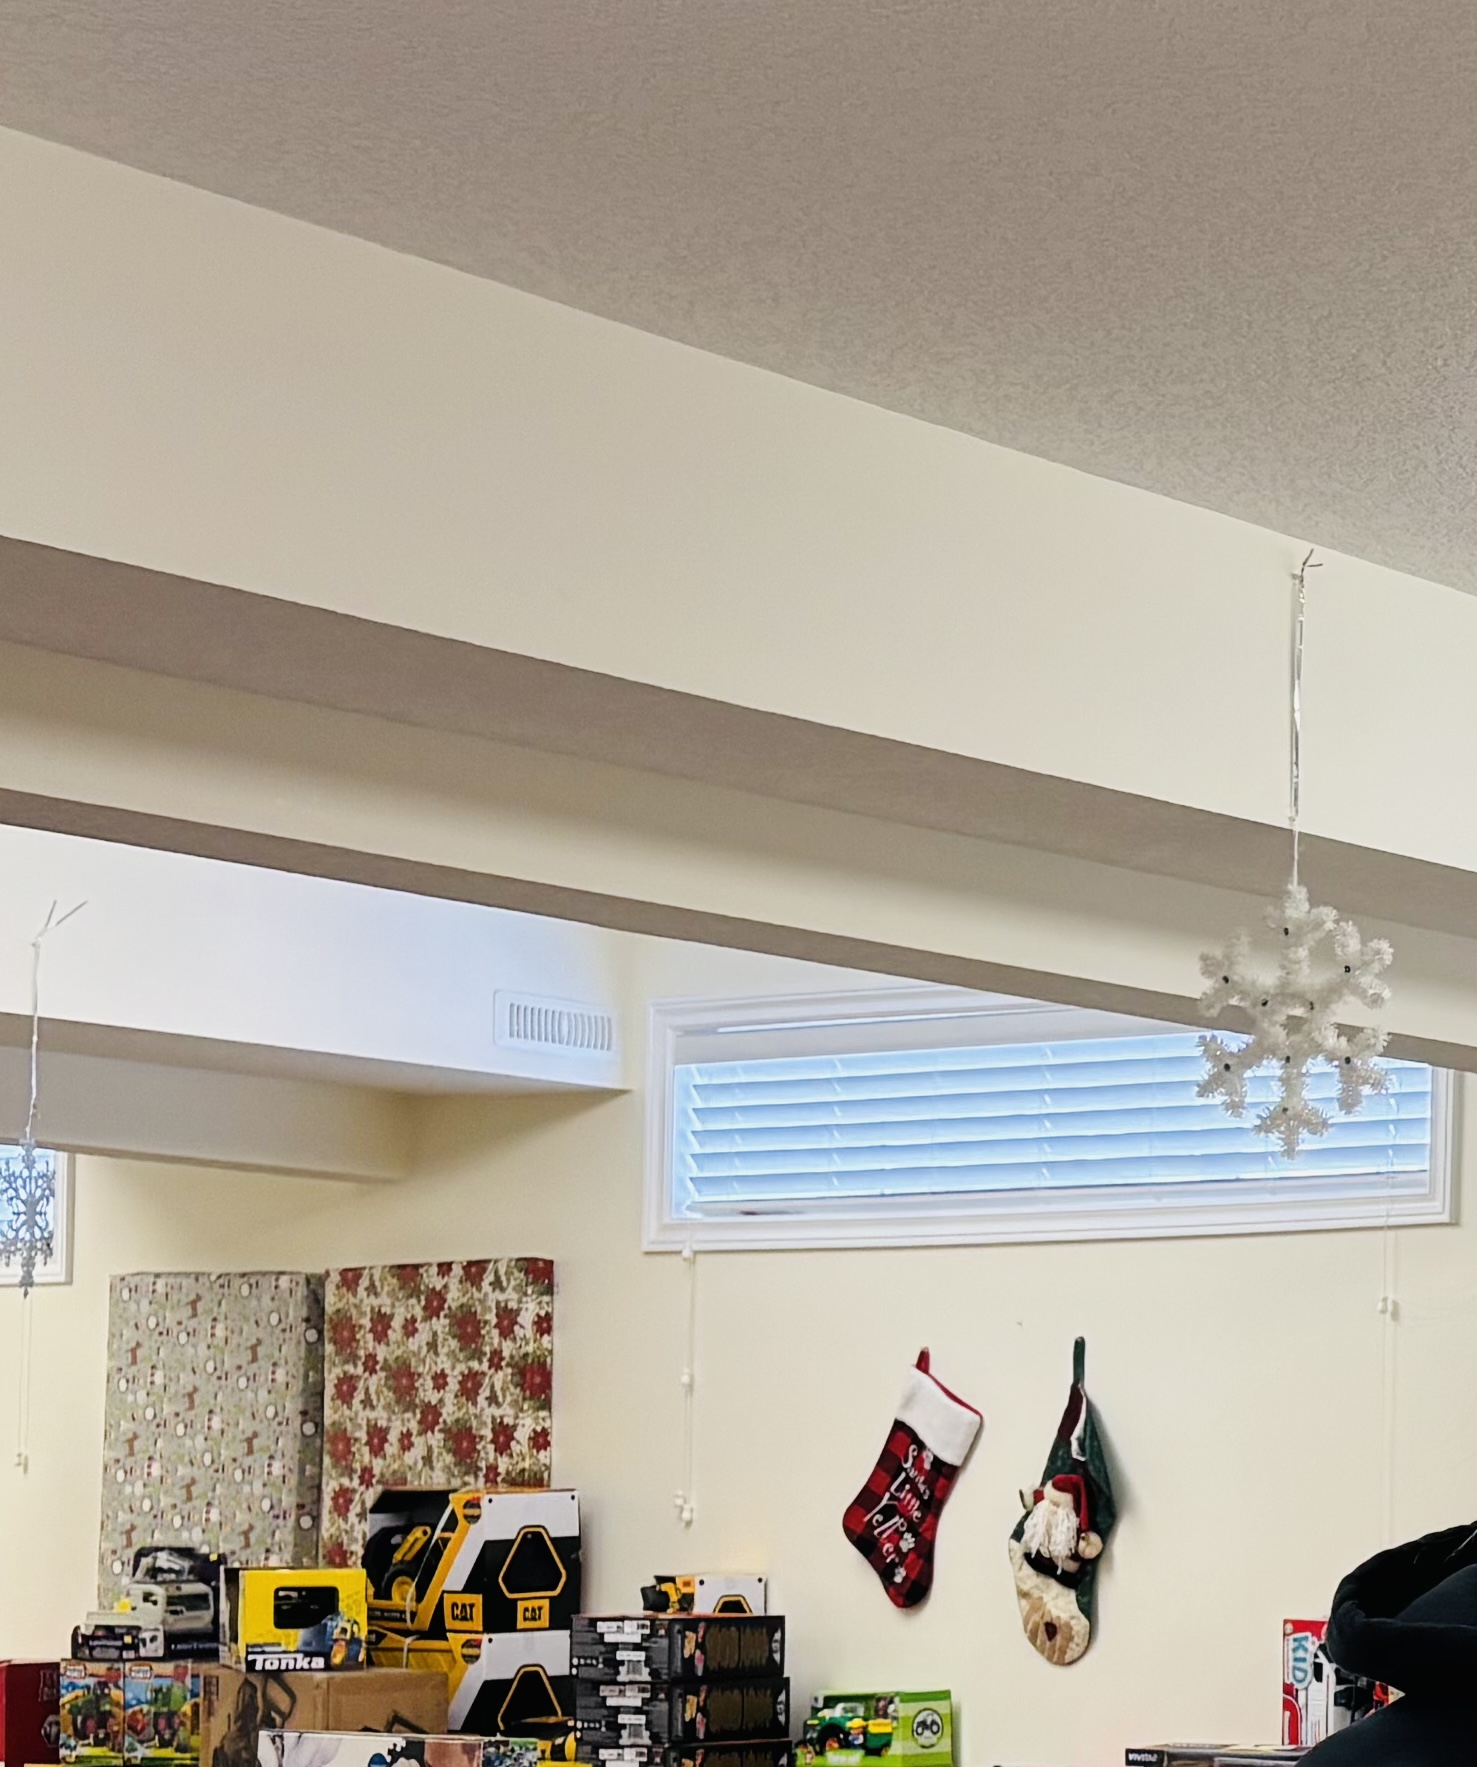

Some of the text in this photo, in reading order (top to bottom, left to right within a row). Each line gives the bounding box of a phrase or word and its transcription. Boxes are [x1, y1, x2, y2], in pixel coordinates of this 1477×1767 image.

[451, 1602, 476, 1623] CAT
[523, 1605, 544, 1622] CAT
[247, 1652, 325, 1672] Tonka
